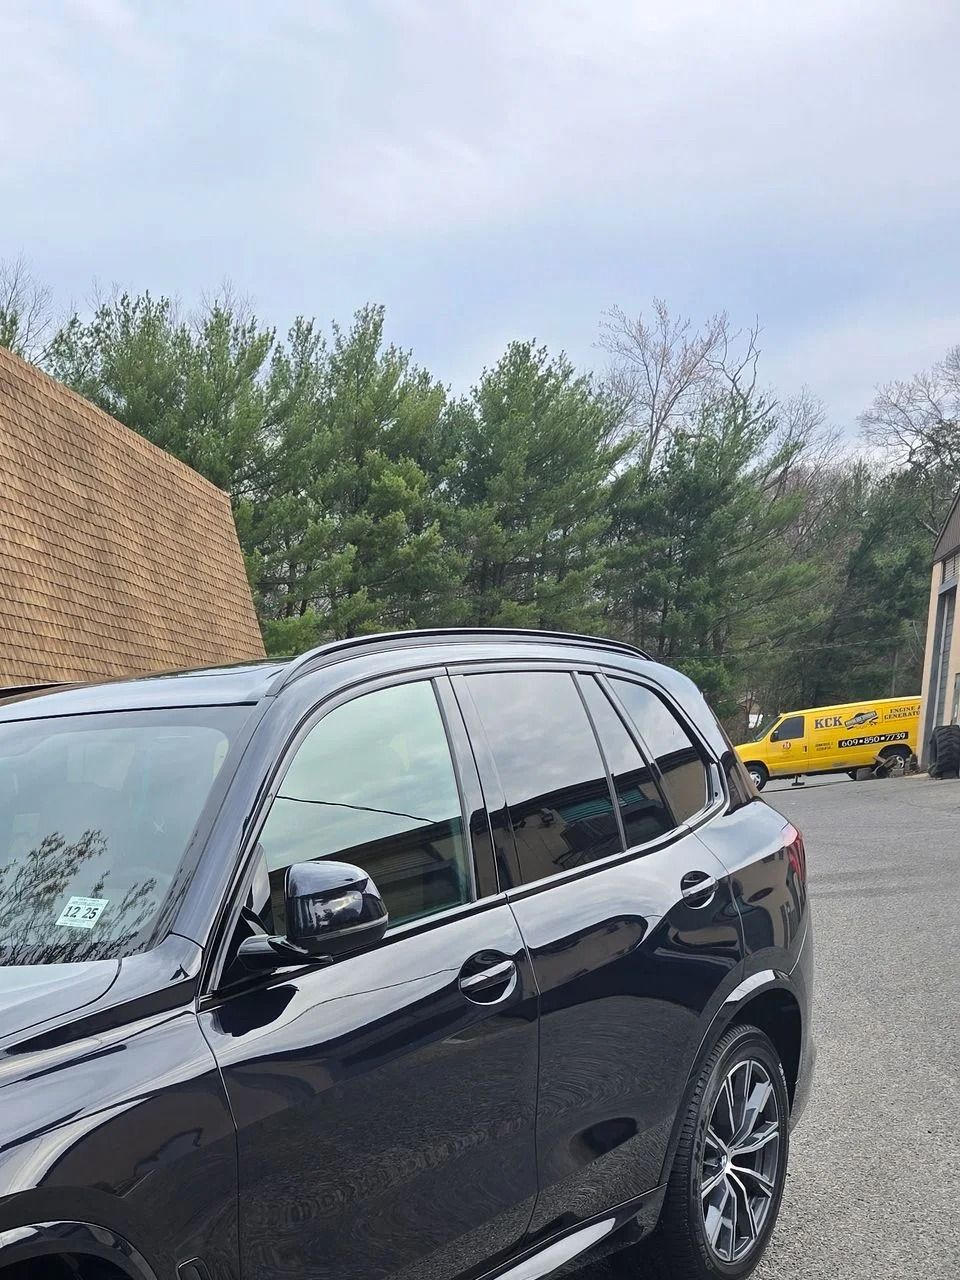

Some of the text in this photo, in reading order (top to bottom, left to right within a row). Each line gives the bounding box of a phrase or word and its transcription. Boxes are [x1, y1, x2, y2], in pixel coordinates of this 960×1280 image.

[814, 716, 842, 729] KCK
[63, 906, 99, 919] 12 25
